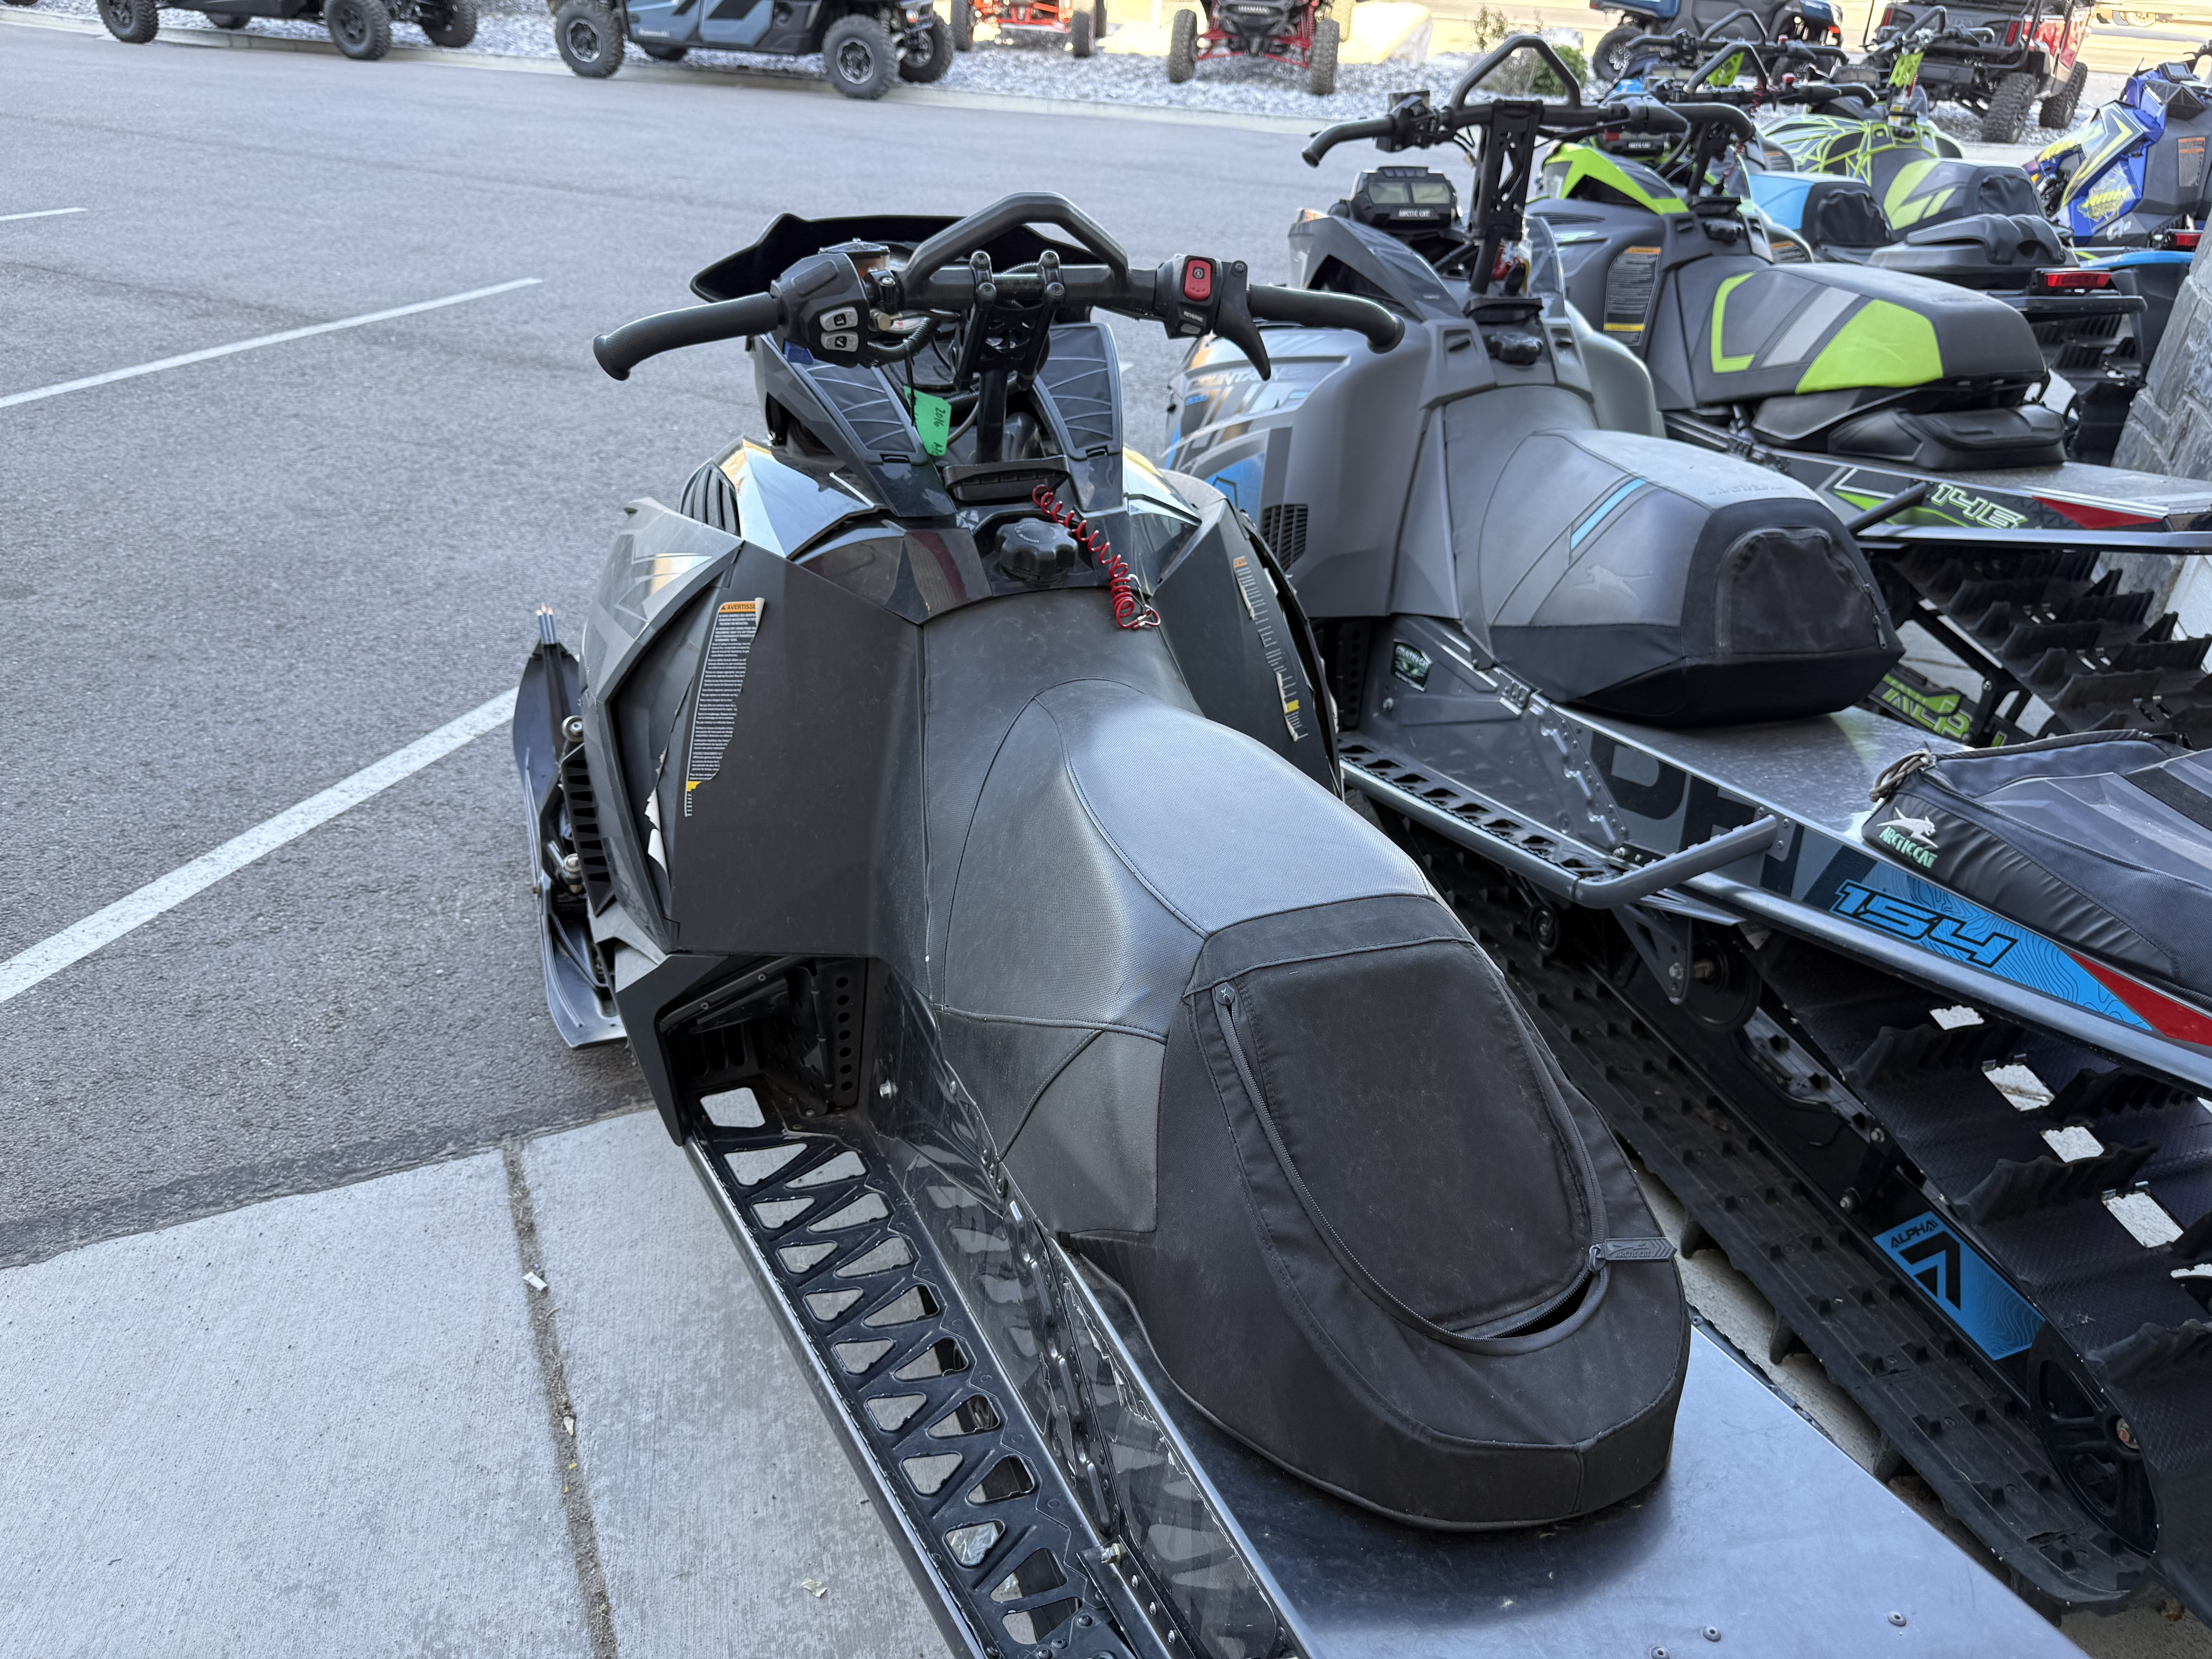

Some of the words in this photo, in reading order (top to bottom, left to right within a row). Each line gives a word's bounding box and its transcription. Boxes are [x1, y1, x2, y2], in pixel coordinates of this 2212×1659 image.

[1398, 209, 1418, 217] ARCTIC
[1419, 209, 1431, 217] CAT
[1183, 311, 1203, 323] REVERSE
[934, 407, 946, 428] 2016
[1879, 826, 1917, 857] ARCTIC
[1912, 846, 1938, 869] CAT
[1831, 881, 2018, 968] 154
